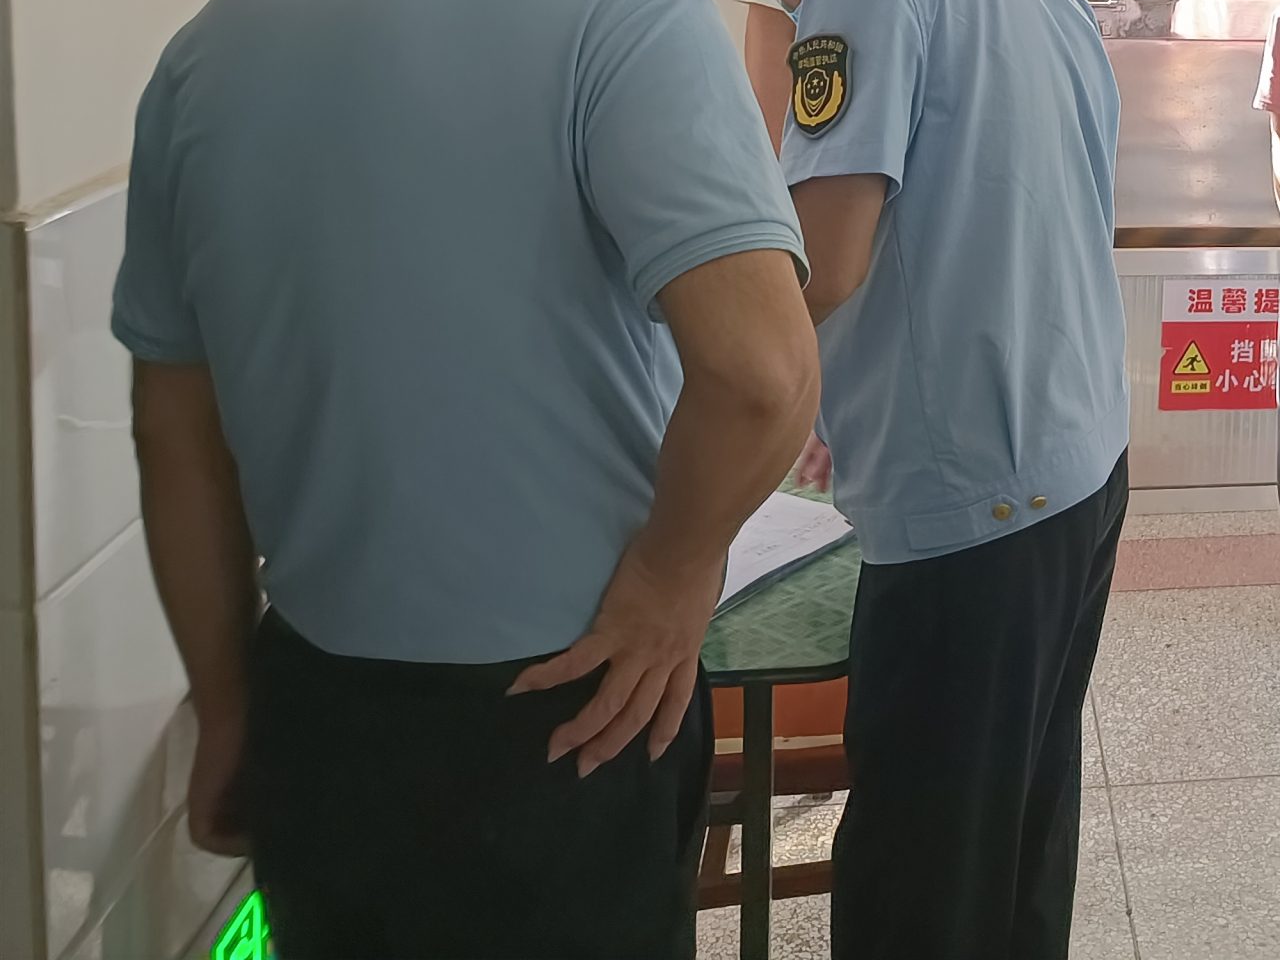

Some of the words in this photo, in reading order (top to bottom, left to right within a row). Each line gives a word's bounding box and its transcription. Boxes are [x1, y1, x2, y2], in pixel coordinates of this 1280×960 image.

[1188, 288, 1279, 314] 温馨提
[1215, 369, 1277, 393] 小心
